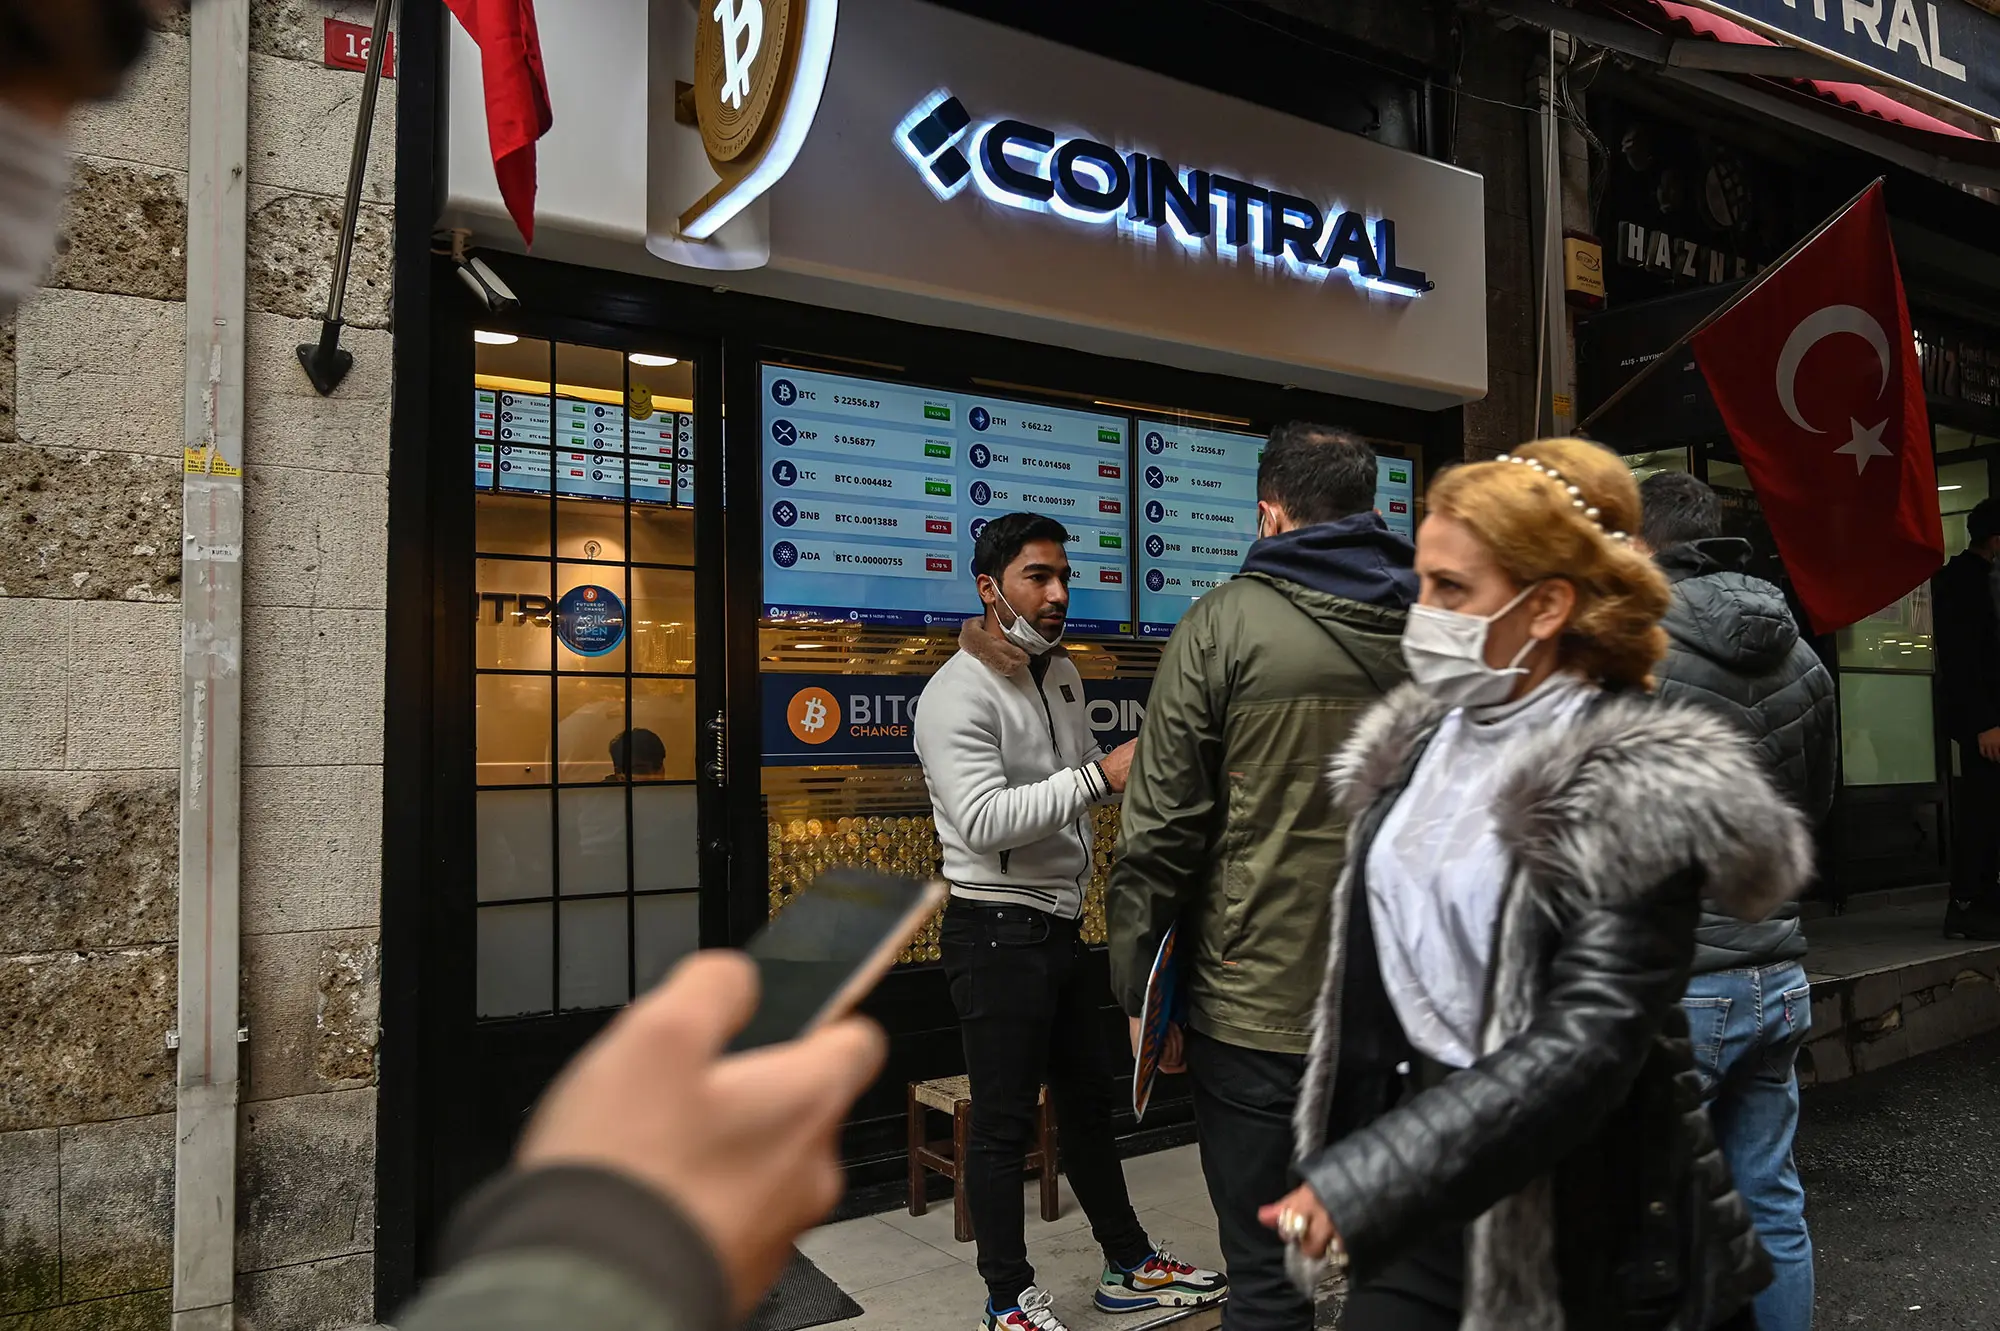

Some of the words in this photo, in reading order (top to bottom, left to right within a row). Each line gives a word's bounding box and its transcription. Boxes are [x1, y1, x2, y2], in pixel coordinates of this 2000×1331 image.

[1783, 0, 1966, 82] RAL
[979, 119, 1427, 292] COINTRAL
[1626, 222, 1766, 284] HAZNE
[1620, 358, 1635, 367] ALIŞ
[800, 390, 817, 401] BTC
[834, 395, 840, 404] $
[842, 396, 880, 409] 22556.87
[992, 417, 1007, 426] ETH
[1022, 421, 1027, 429] $
[1028, 422, 1053, 432] 662.22
[798, 430, 818, 441] XRP
[834, 435, 840, 444] $
[842, 436, 876, 448] 0.56877
[1165, 442, 1178, 450] BTC
[1197, 446, 1225, 456] 22556.87
[992, 454, 1009, 463] BCH
[1022, 458, 1037, 467] BTC
[1038, 460, 1071, 470] 0.014508
[800, 471, 817, 481] LTC
[835, 474, 852, 484] BTC
[854, 476, 893, 488] 0.004482
[1165, 475, 1179, 483] XRP
[1197, 479, 1222, 488] 0.56877
[993, 491, 1008, 500] EOS
[1022, 494, 1037, 503] BTC
[1038, 496, 1075, 507] 0.0001397
[800, 511, 820, 521] BNB
[1166, 509, 1178, 517] LTC
[1192, 512, 1204, 520] BTC
[1206, 513, 1234, 523] 0.004482
[835, 514, 852, 523] BTC
[854, 516, 898, 527] 0.0013888
[1192, 546, 1204, 554] BTC
[1206, 547, 1238, 556] 0.0013888
[800, 552, 820, 561] ADA
[836, 554, 852, 563] BTC
[854, 556, 903, 566] 0.00000755
[1166, 578, 1181, 586] ADA
[1192, 580, 1204, 588] BTC
[575, 626, 608, 635] OPEN
[850, 725, 908, 736] CHANGE
